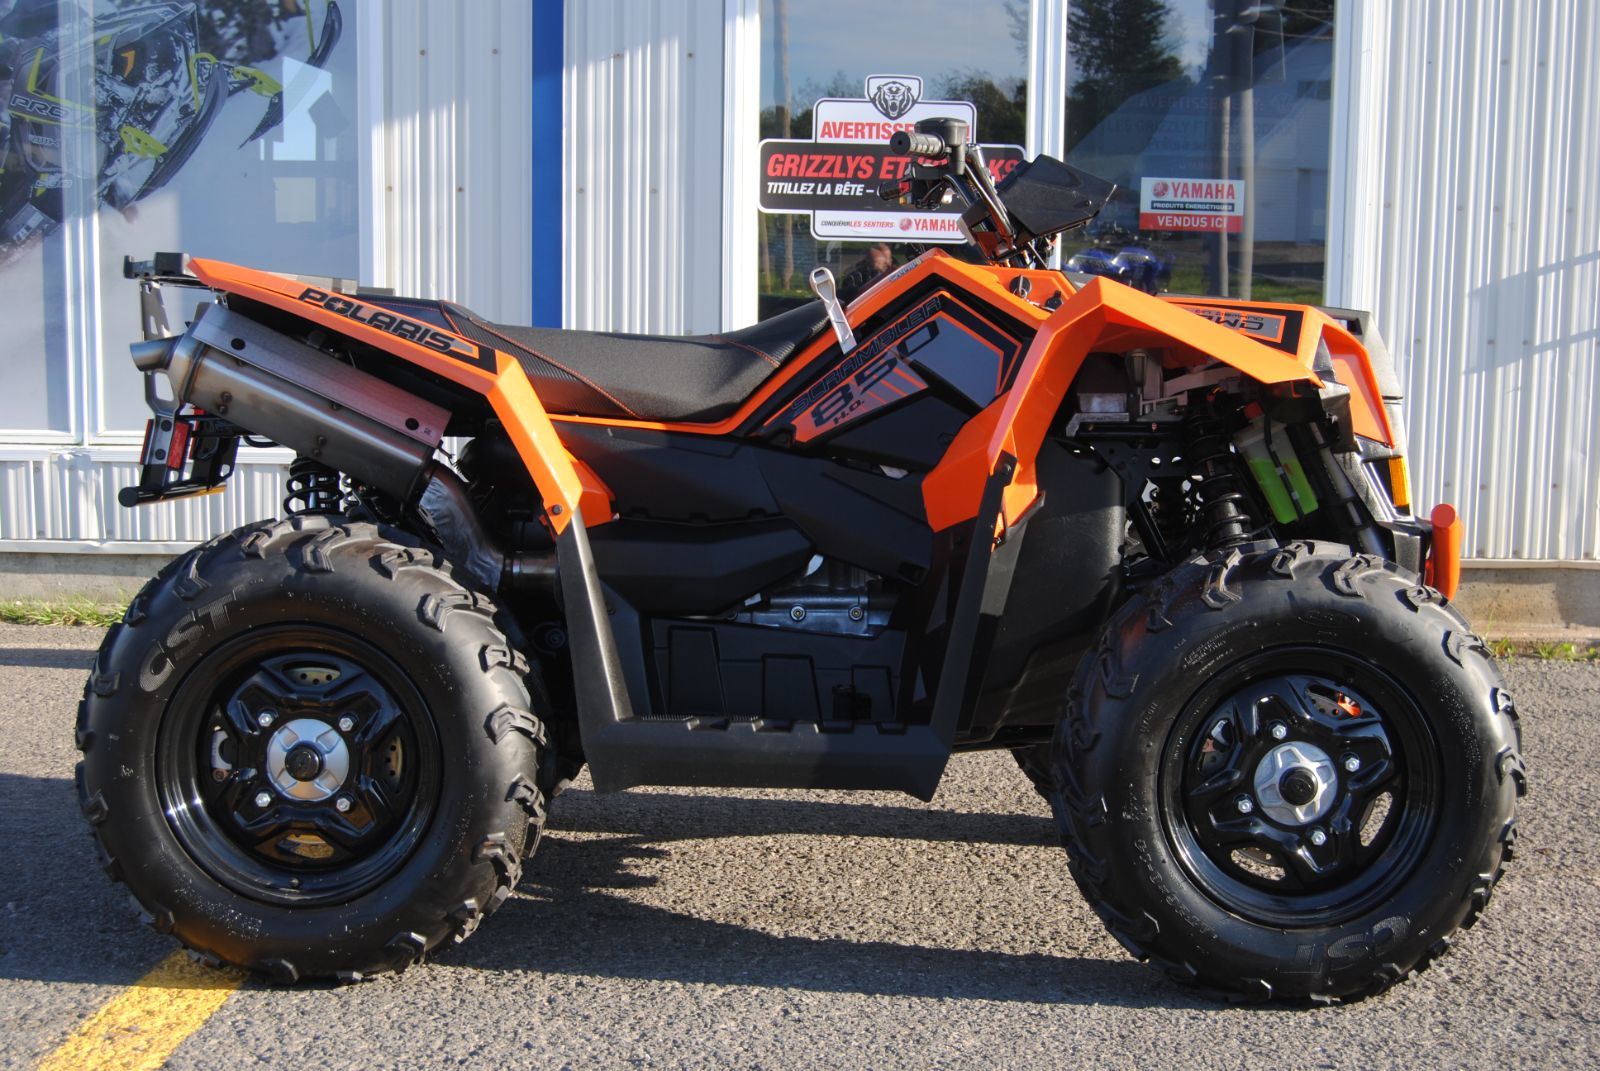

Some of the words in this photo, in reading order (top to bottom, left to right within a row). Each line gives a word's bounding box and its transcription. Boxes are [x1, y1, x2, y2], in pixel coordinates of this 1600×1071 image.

[767, 153, 875, 179] GRIZZLYS
[879, 156, 912, 180] ET
[767, 182, 816, 195] TITILLEZ
[816, 183, 832, 196] LA
[834, 181, 865, 196] BÊTE
[1171, 182, 1236, 200] YAMAHA
[863, 220, 894, 229] SENTIERS
[1157, 215, 1208, 228] VENDUS
[1211, 217, 1227, 229] ICI
[297, 287, 456, 353] POLARIS
[791, 294, 943, 412] SCRAMBLER
[811, 318, 940, 428] 850
[139, 590, 236, 693] CST
